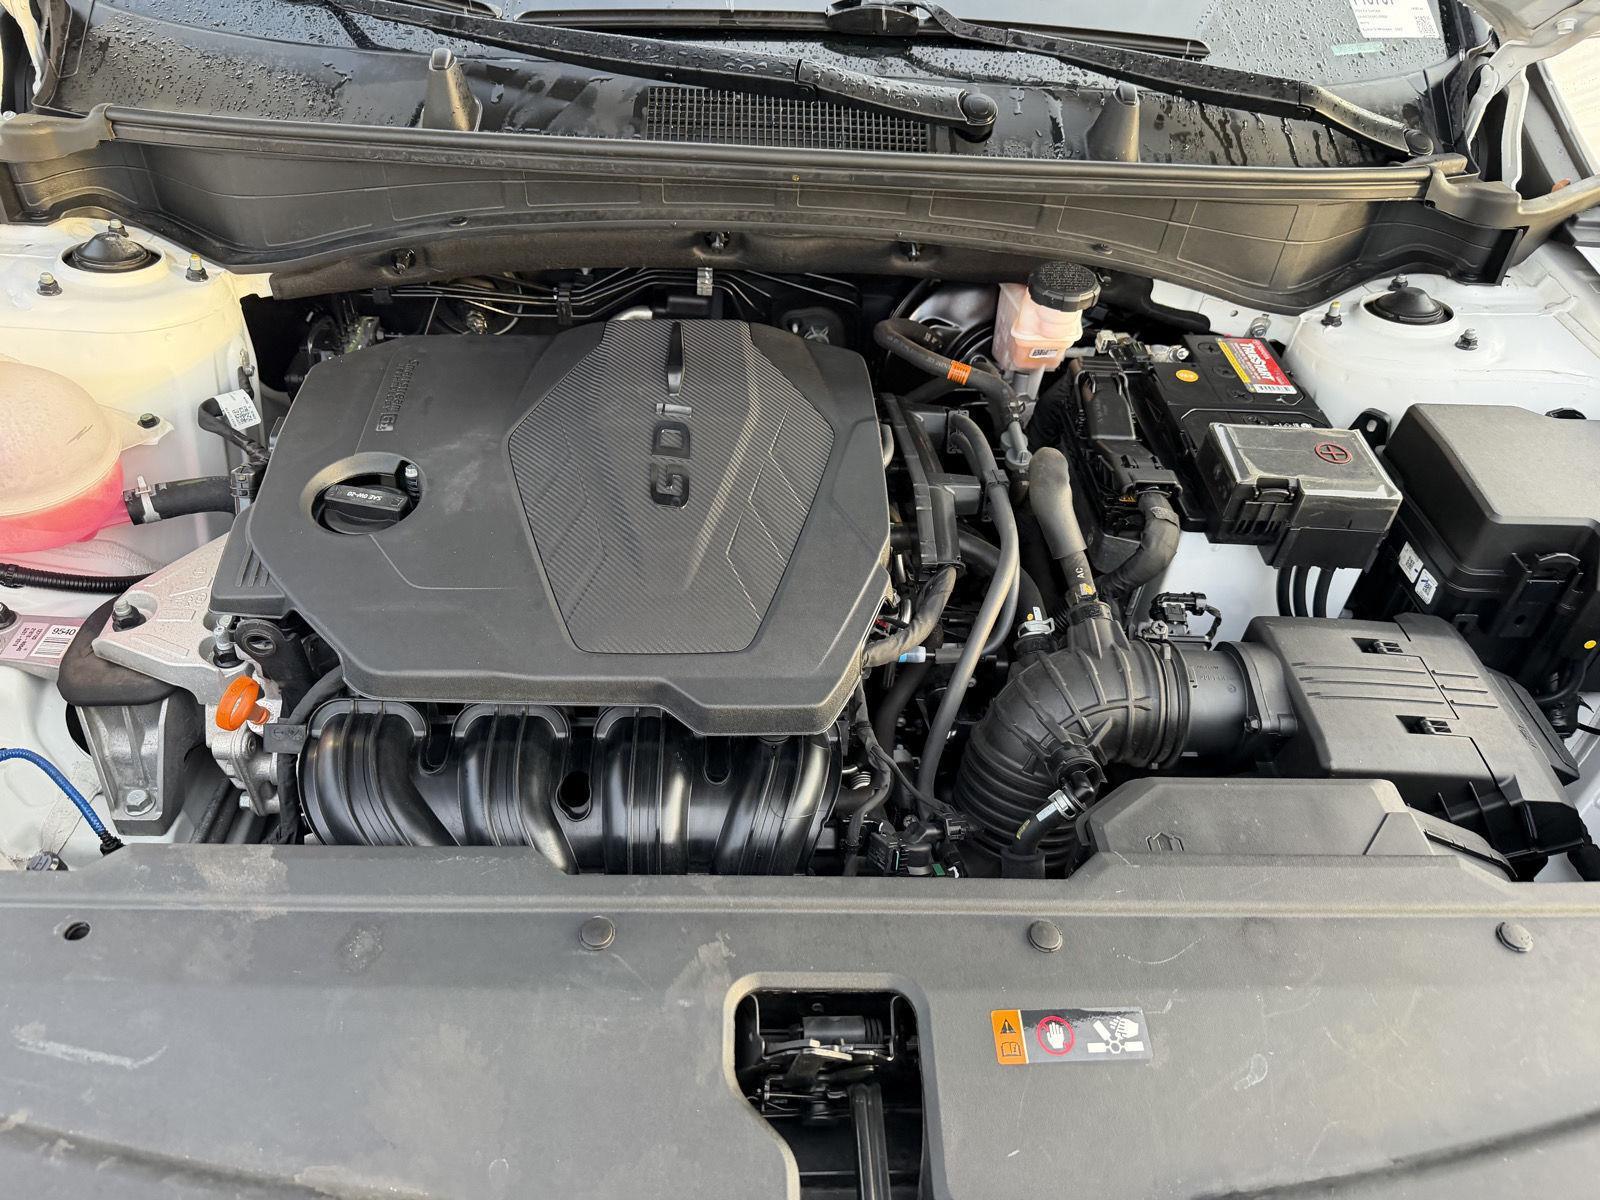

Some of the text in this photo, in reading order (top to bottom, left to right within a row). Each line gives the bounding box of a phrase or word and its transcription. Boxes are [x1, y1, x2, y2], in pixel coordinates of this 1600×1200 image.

[346, 491, 369, 500] 0W-20
[1075, 567, 1086, 579] AC
[52, 627, 77, 636] 9540
